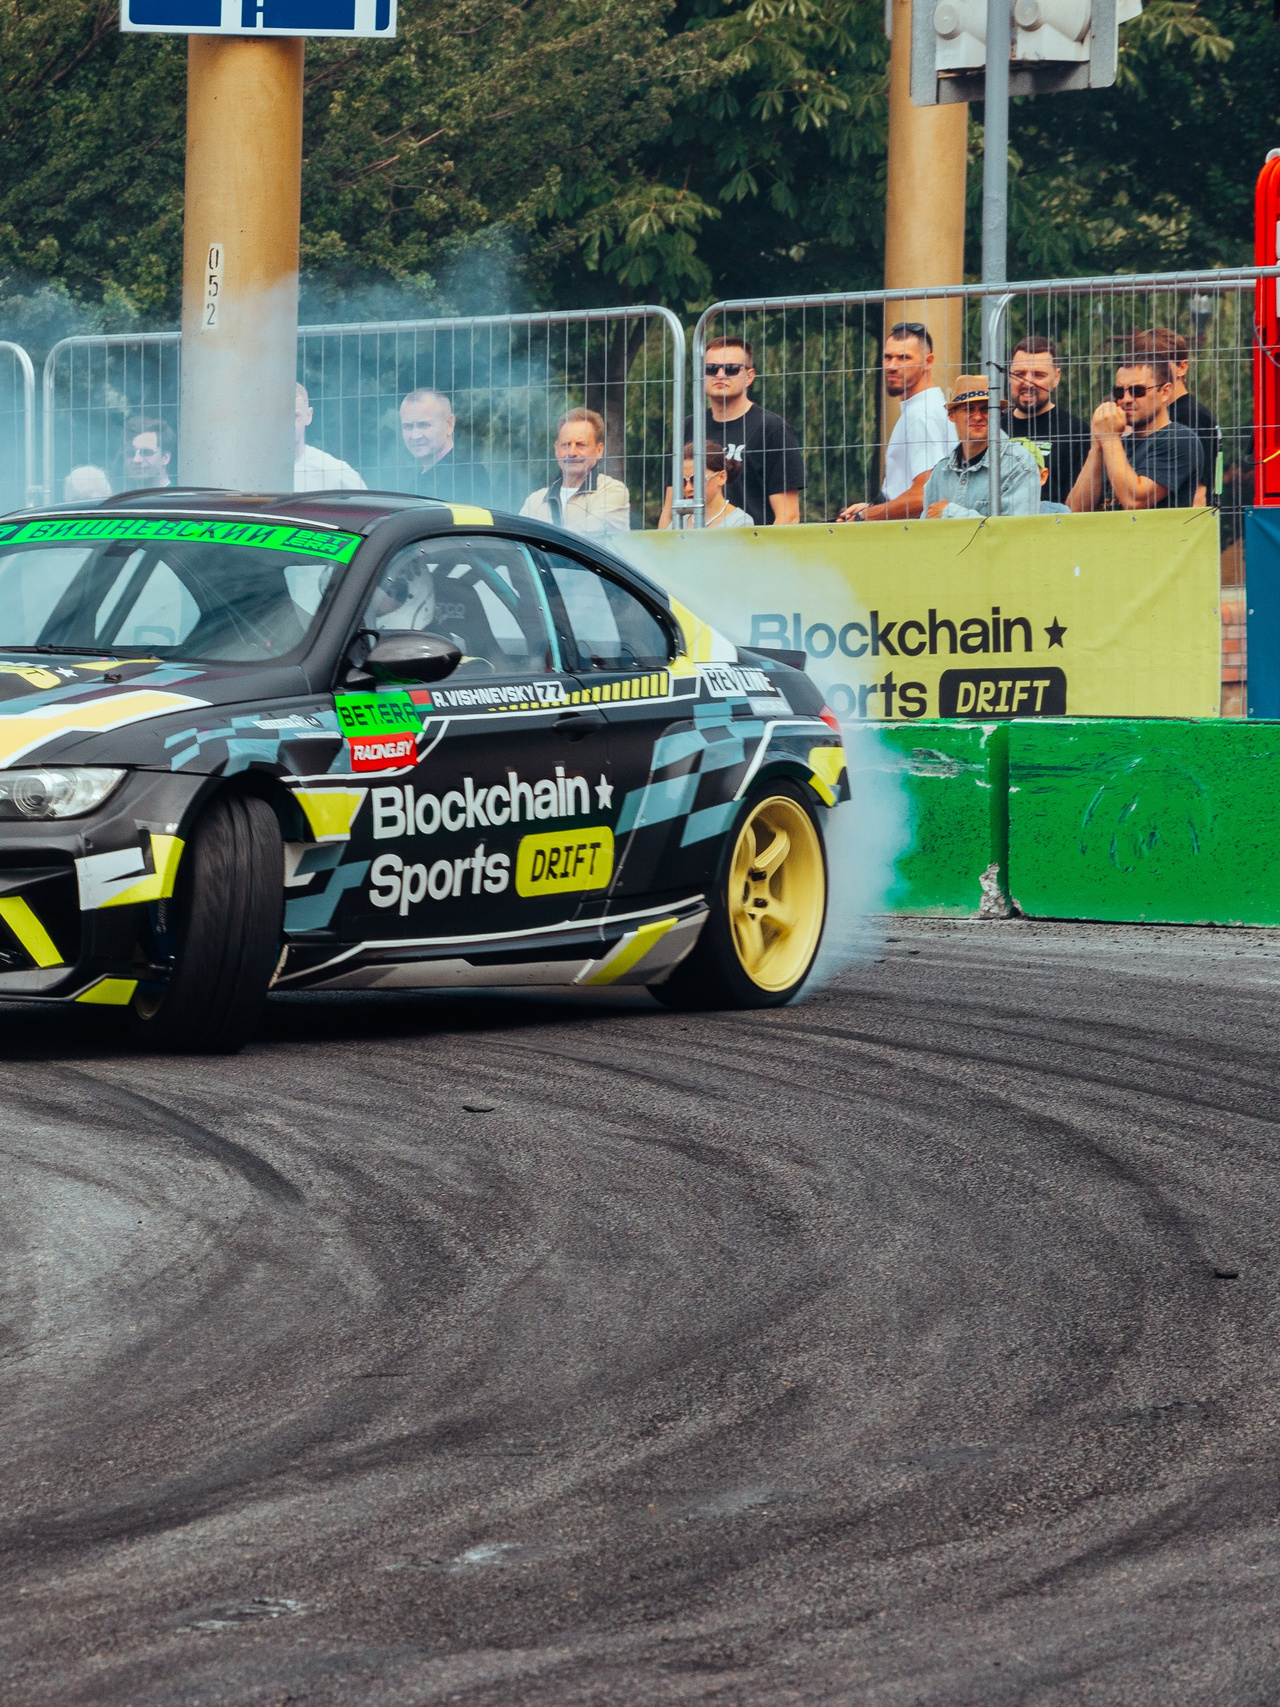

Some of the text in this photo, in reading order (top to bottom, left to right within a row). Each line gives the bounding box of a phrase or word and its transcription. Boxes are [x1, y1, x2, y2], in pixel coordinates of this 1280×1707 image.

[207, 248, 219, 325] 052
[749, 606, 1033, 658] Blockchain
[338, 702, 420, 727] BET.ERA
[826, 671, 1051, 718] orts DRIFT
[371, 766, 590, 839] Blockchain
[369, 842, 601, 916] Sports DRIFT
